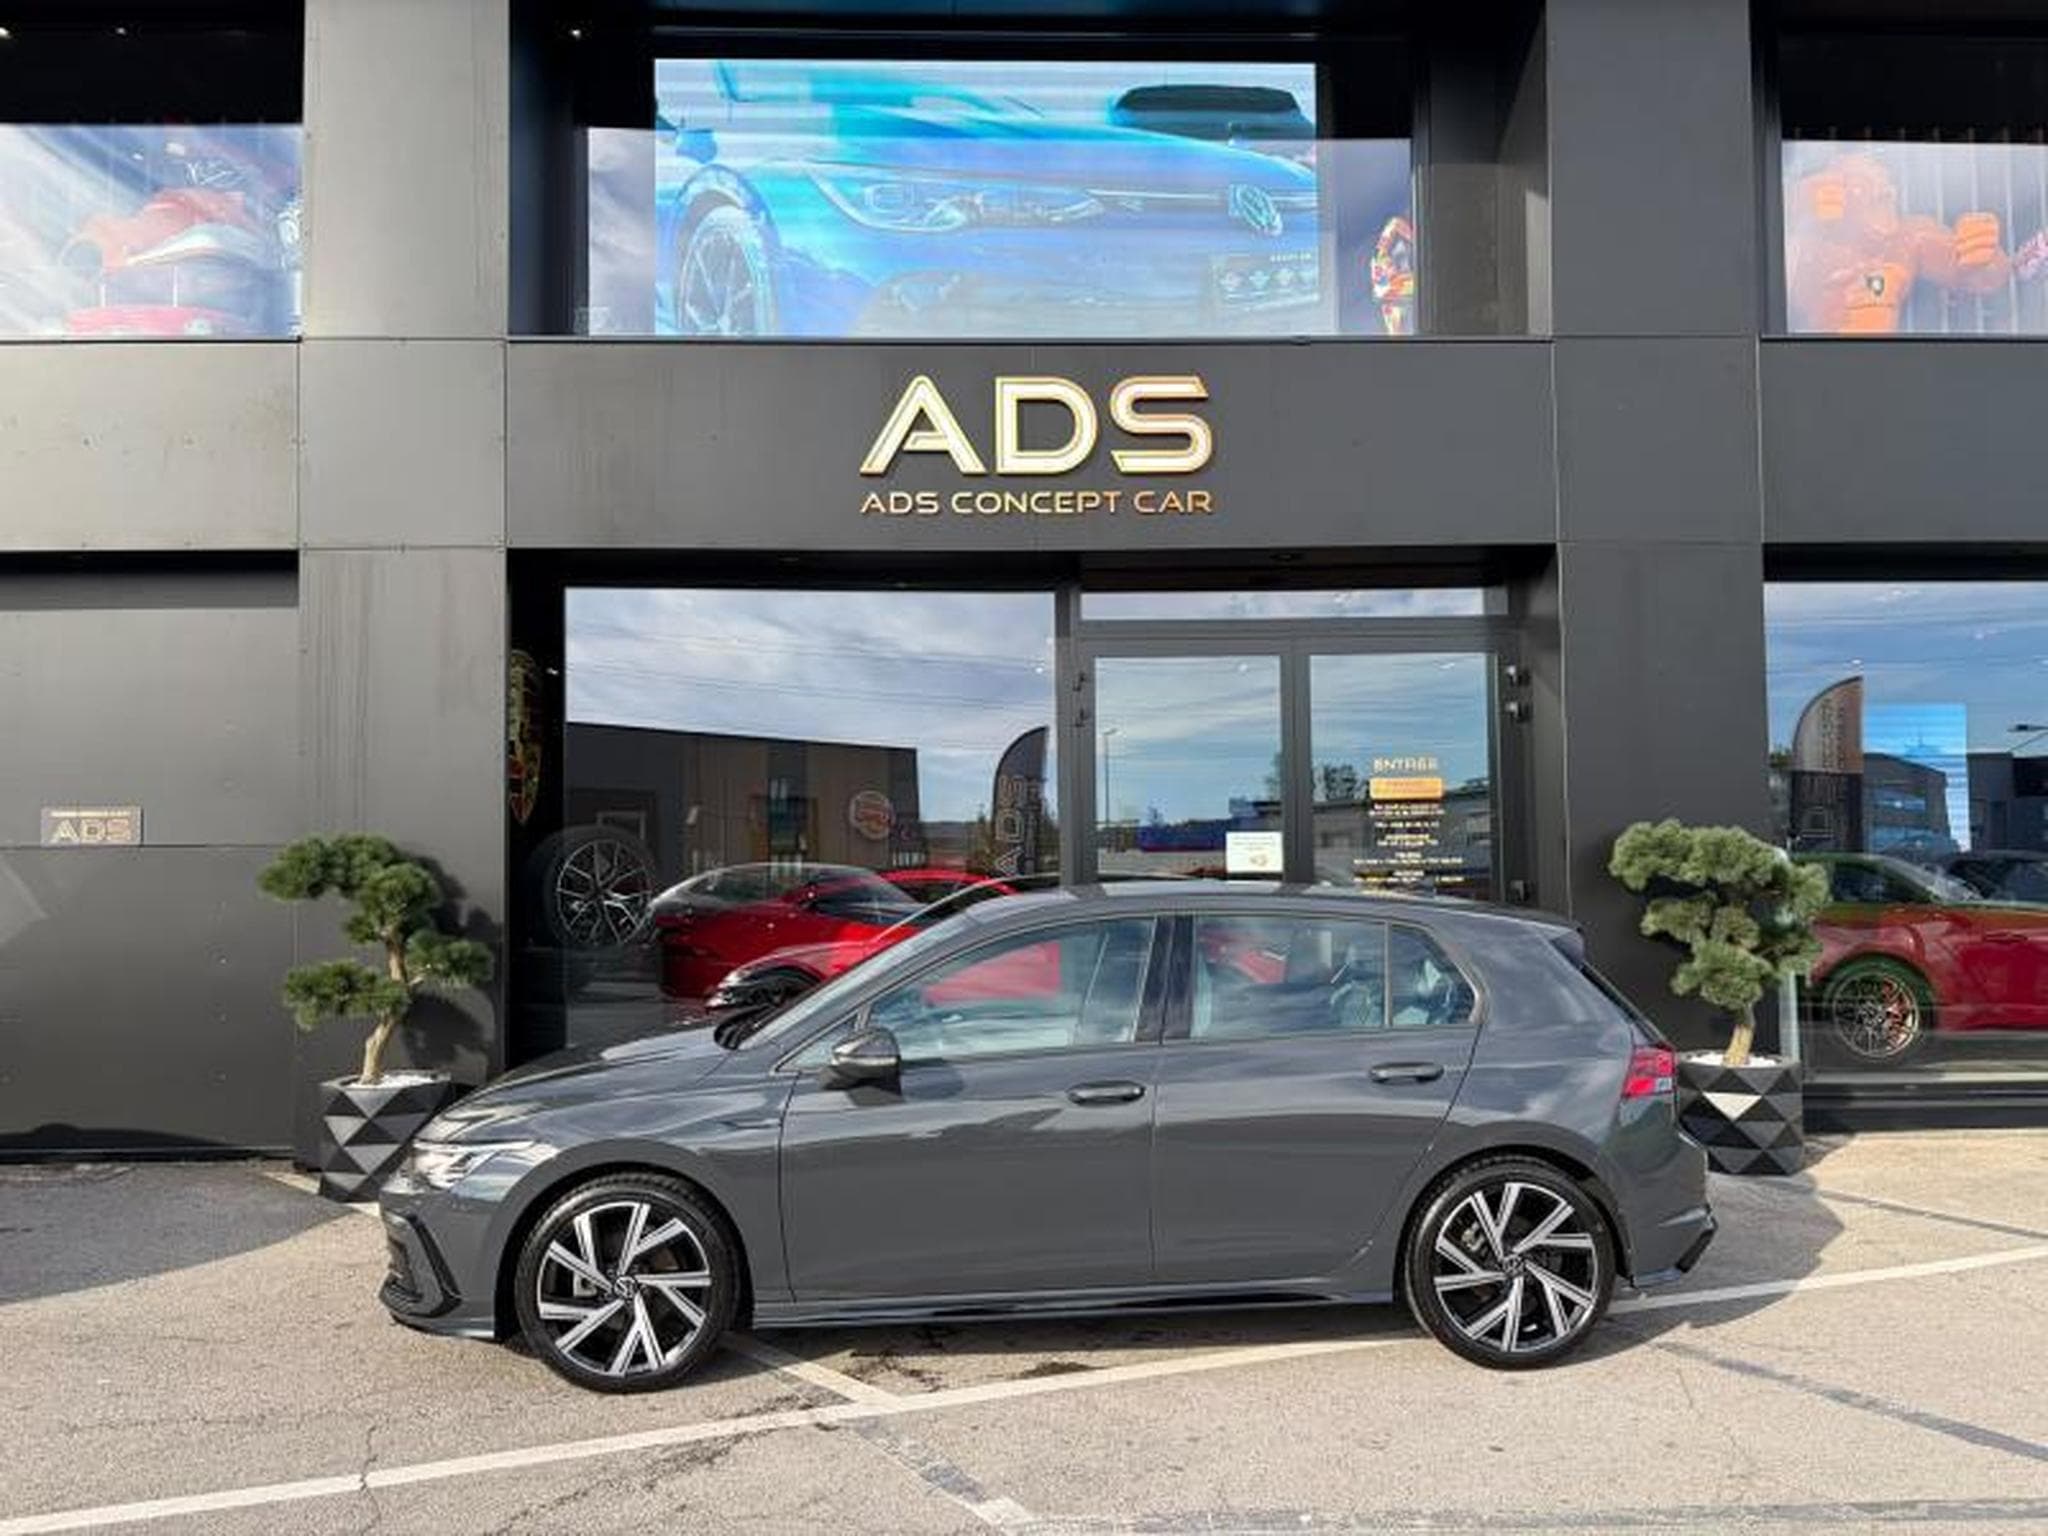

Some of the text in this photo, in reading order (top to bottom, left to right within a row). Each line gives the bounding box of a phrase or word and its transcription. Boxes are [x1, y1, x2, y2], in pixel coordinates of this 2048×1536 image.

[860, 374, 1213, 474] ADS
[860, 490, 1213, 514] ADS CONCEPT CAR
[53, 819, 131, 843] ADS
